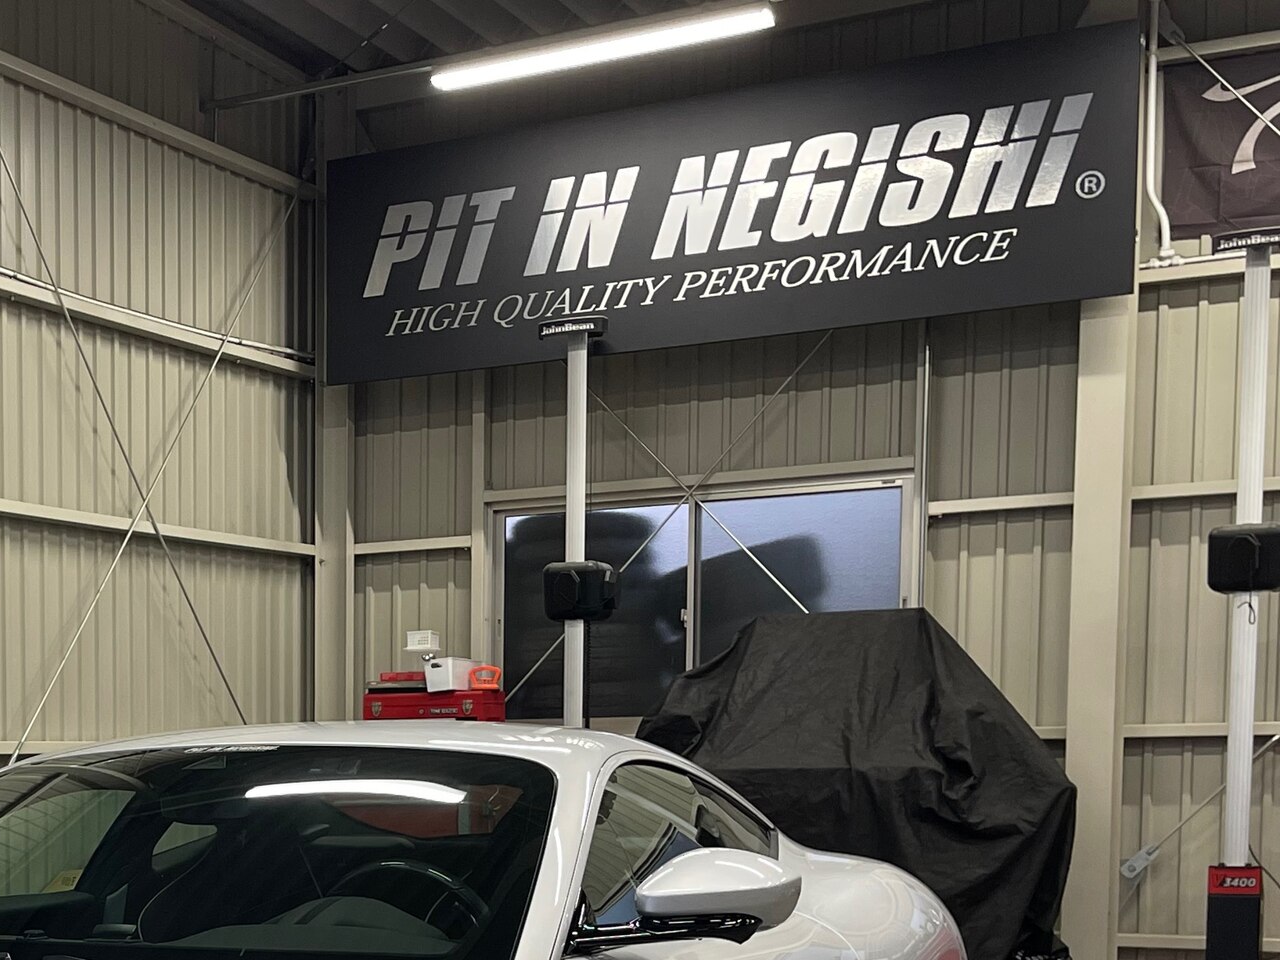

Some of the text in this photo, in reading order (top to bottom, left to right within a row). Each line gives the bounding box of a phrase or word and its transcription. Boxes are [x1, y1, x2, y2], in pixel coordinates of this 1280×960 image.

[363, 92, 1094, 298] PIT IN NEGISHI
[1217, 233, 1280, 250] JohnBea
[385, 227, 1018, 337] HIGH QUALITY PERFORMANCE
[540, 322, 595, 335] JohnBean
